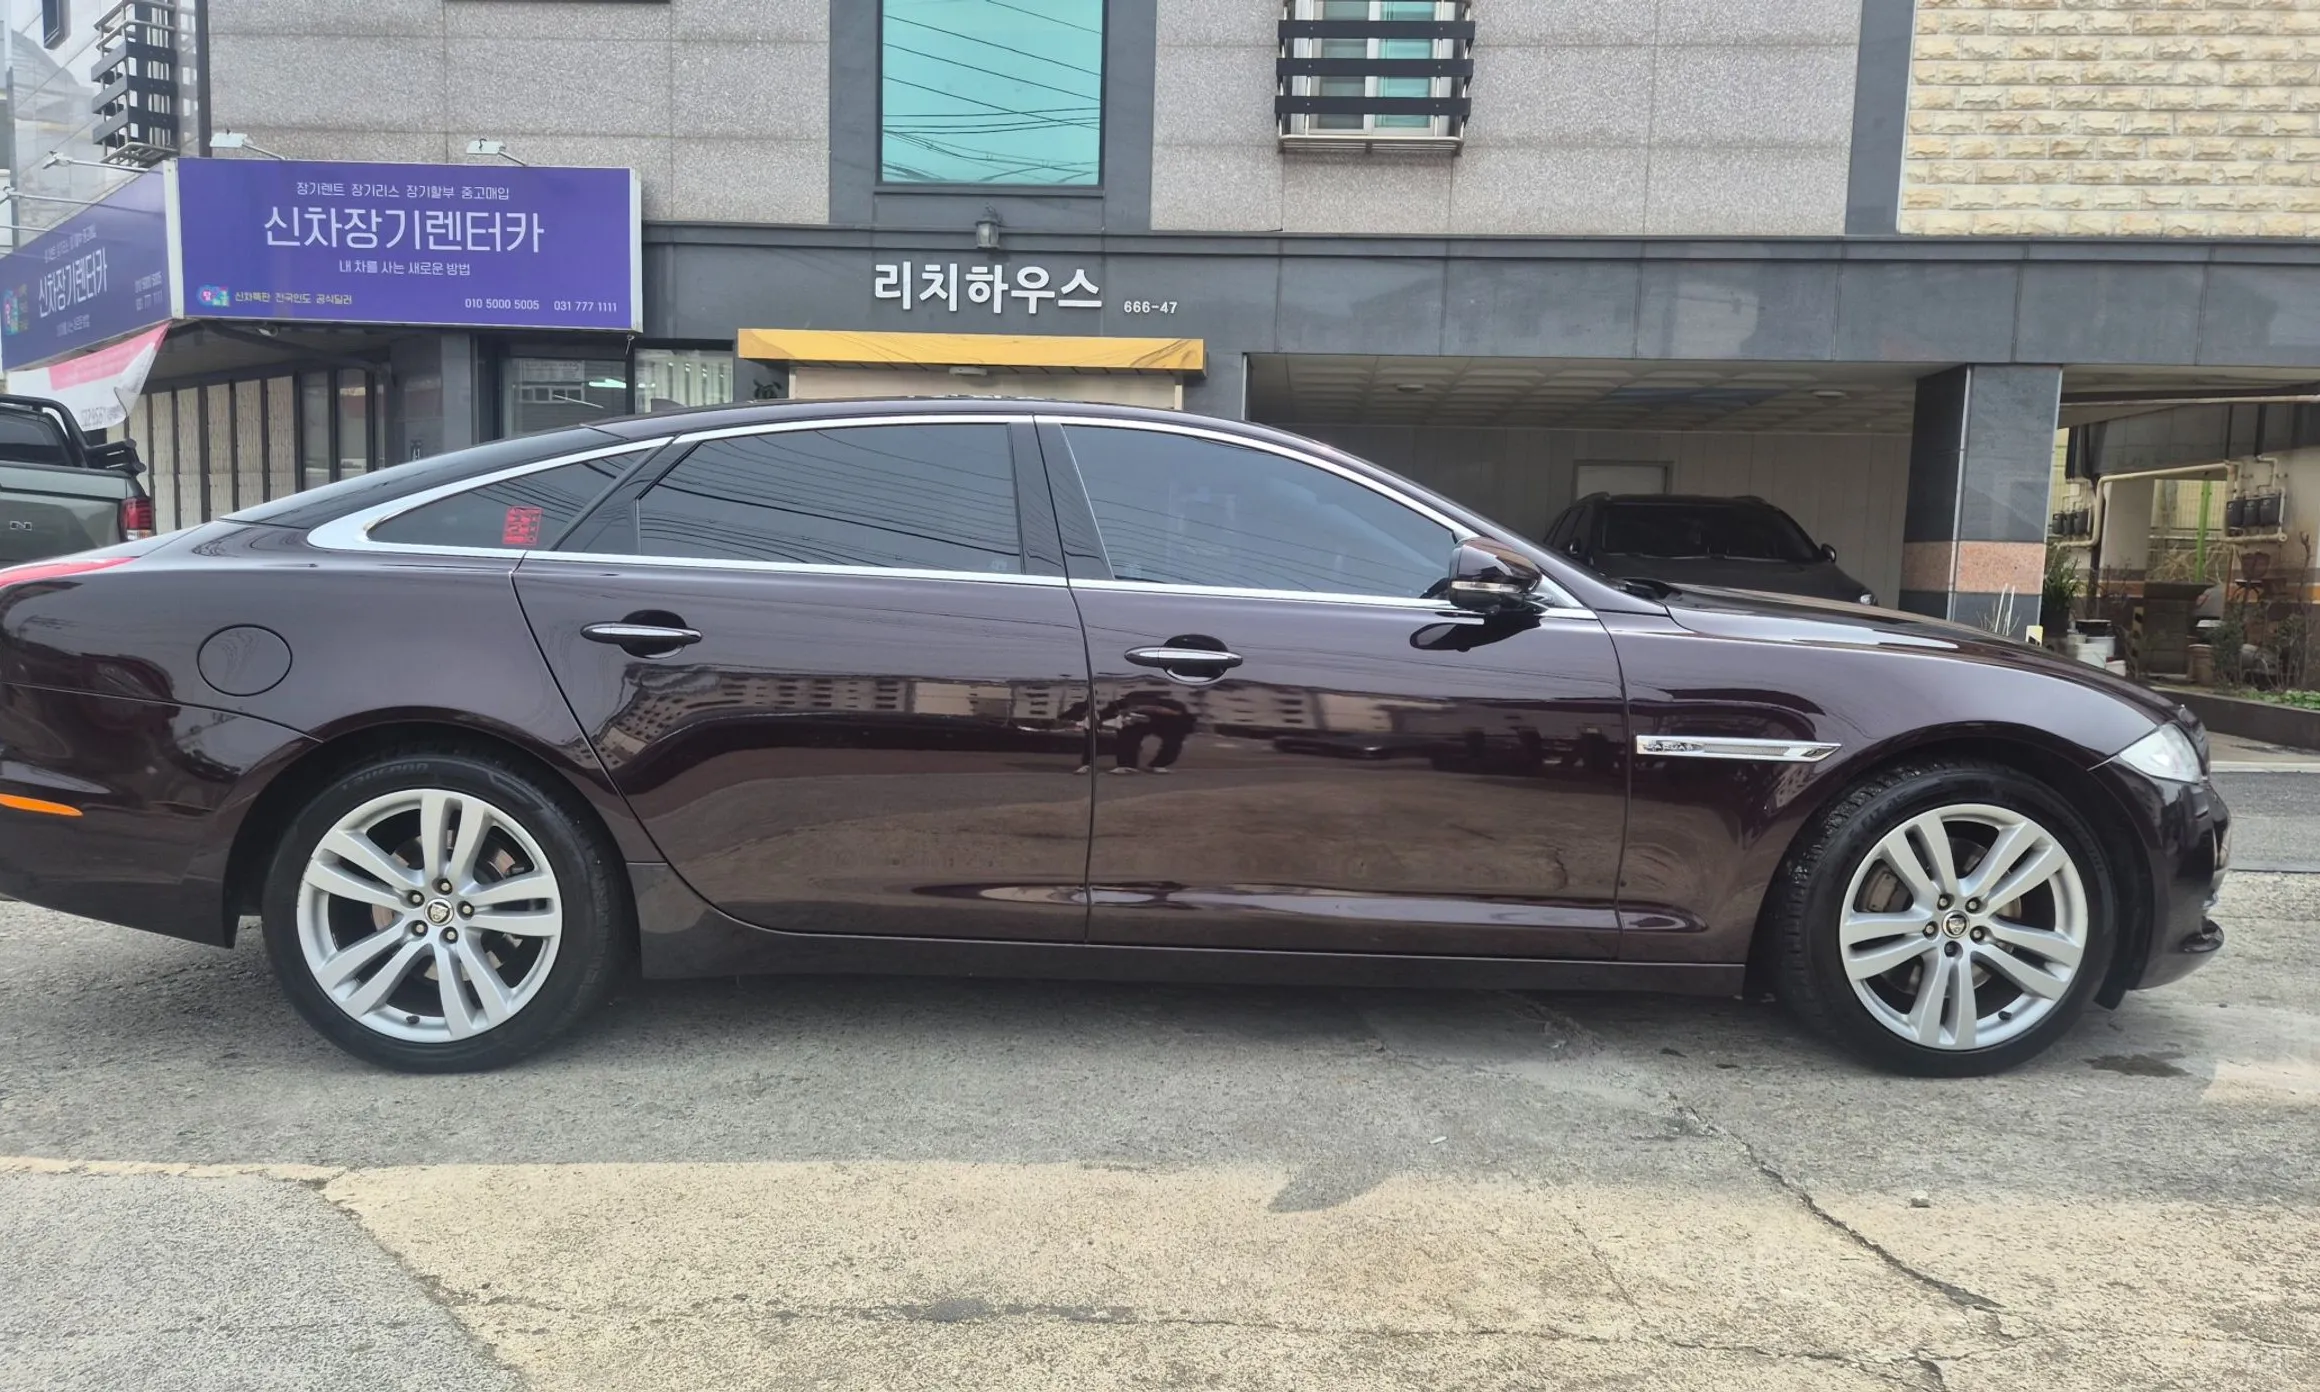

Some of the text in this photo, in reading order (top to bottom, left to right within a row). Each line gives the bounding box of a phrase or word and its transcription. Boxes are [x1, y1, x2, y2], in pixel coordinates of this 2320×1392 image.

[296, 181, 509, 200] 장기렌트 장기리스 장기할부 중고매입
[264, 206, 545, 253] 신차장기렌터카
[339, 259, 352, 273] 내
[381, 260, 405, 275] 사는
[408, 261, 444, 276] 새로운
[446, 262, 471, 276] 방법
[39, 246, 107, 318] 신차장기렌터카
[875, 260, 1103, 314] 리치하우스
[465, 298, 540, 310] 010 5000 5005
[554, 300, 617, 312] 031 777 1111
[1123, 300, 1178, 315] 666-47
